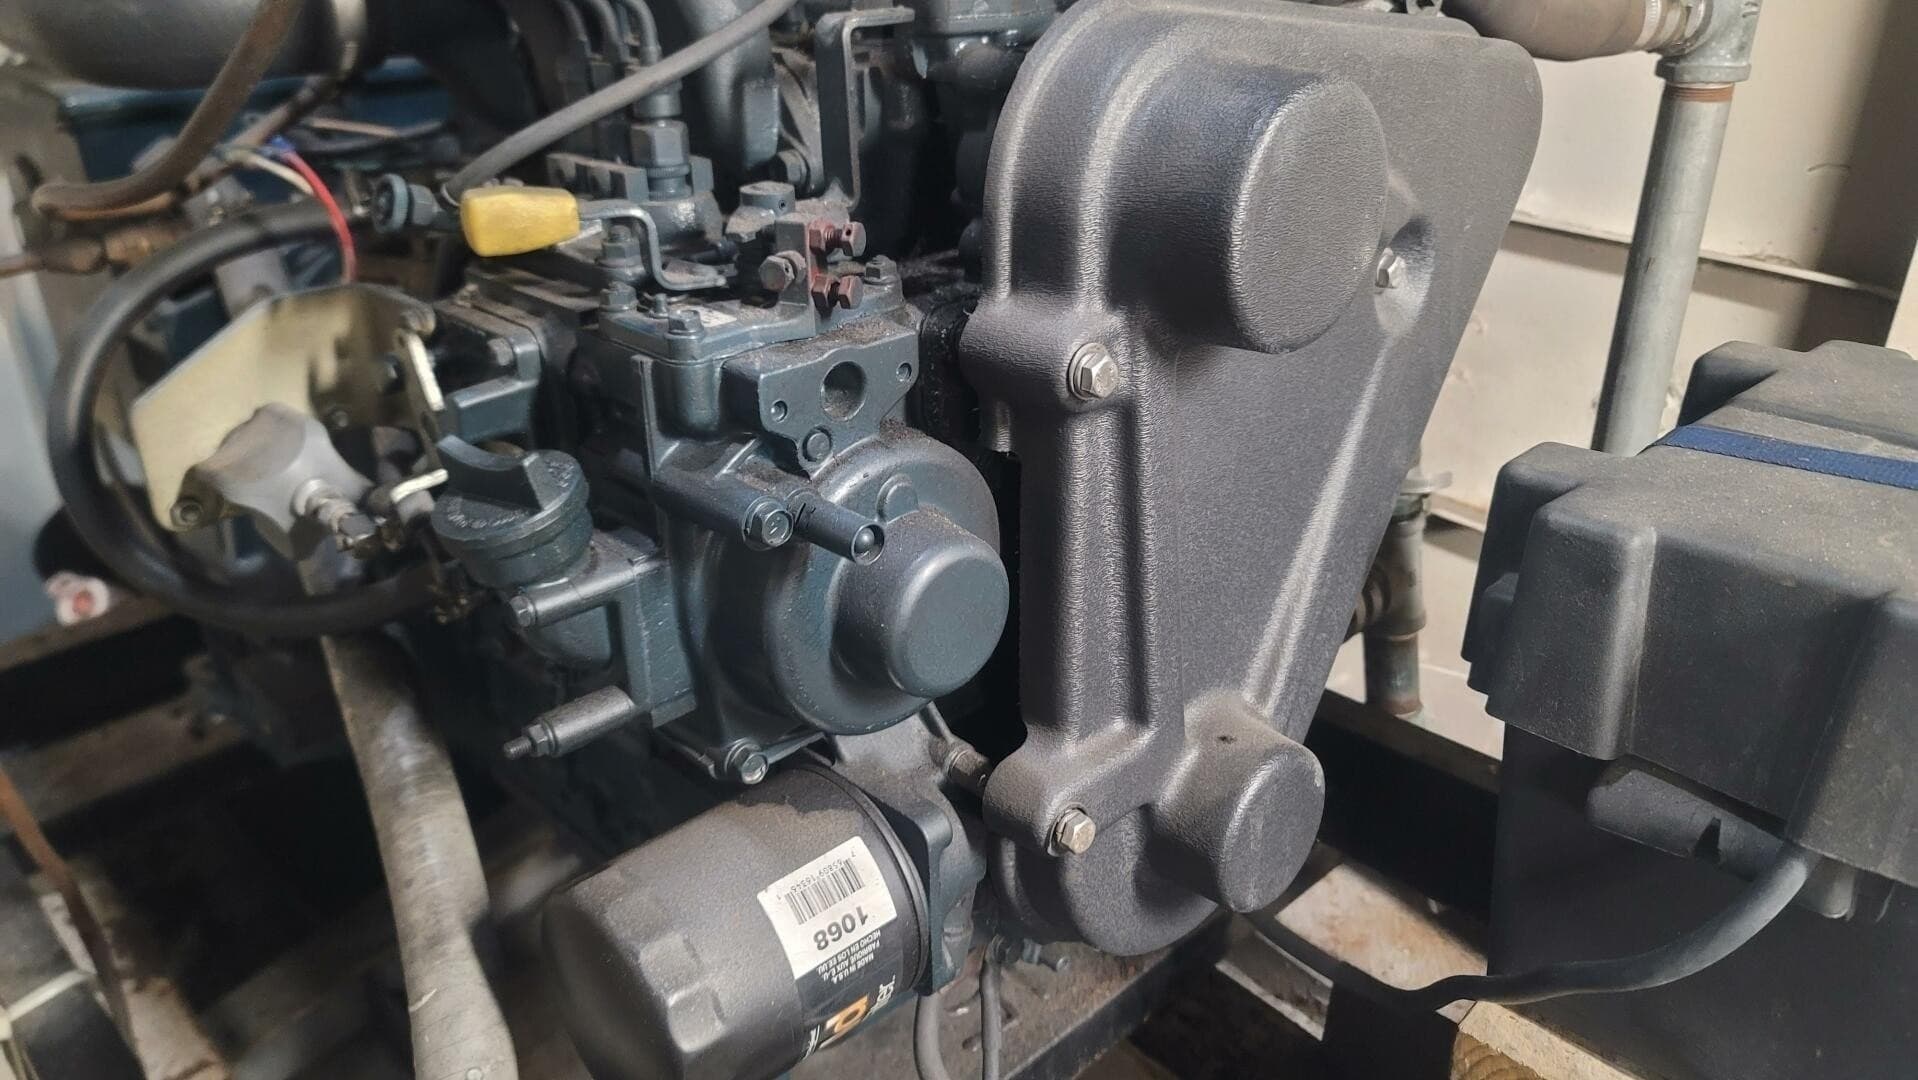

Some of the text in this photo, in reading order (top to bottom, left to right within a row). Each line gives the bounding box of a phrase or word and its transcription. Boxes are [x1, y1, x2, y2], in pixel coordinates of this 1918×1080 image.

[818, 859, 842, 878] 65809
[813, 905, 869, 951] 1068
[860, 928, 881, 949] HECHO
[837, 948, 850, 962] LOS
[850, 942, 860, 955] EN
[836, 958, 849, 972] AUX
[856, 951, 874, 969] MADE
[849, 963, 857, 974] IN
